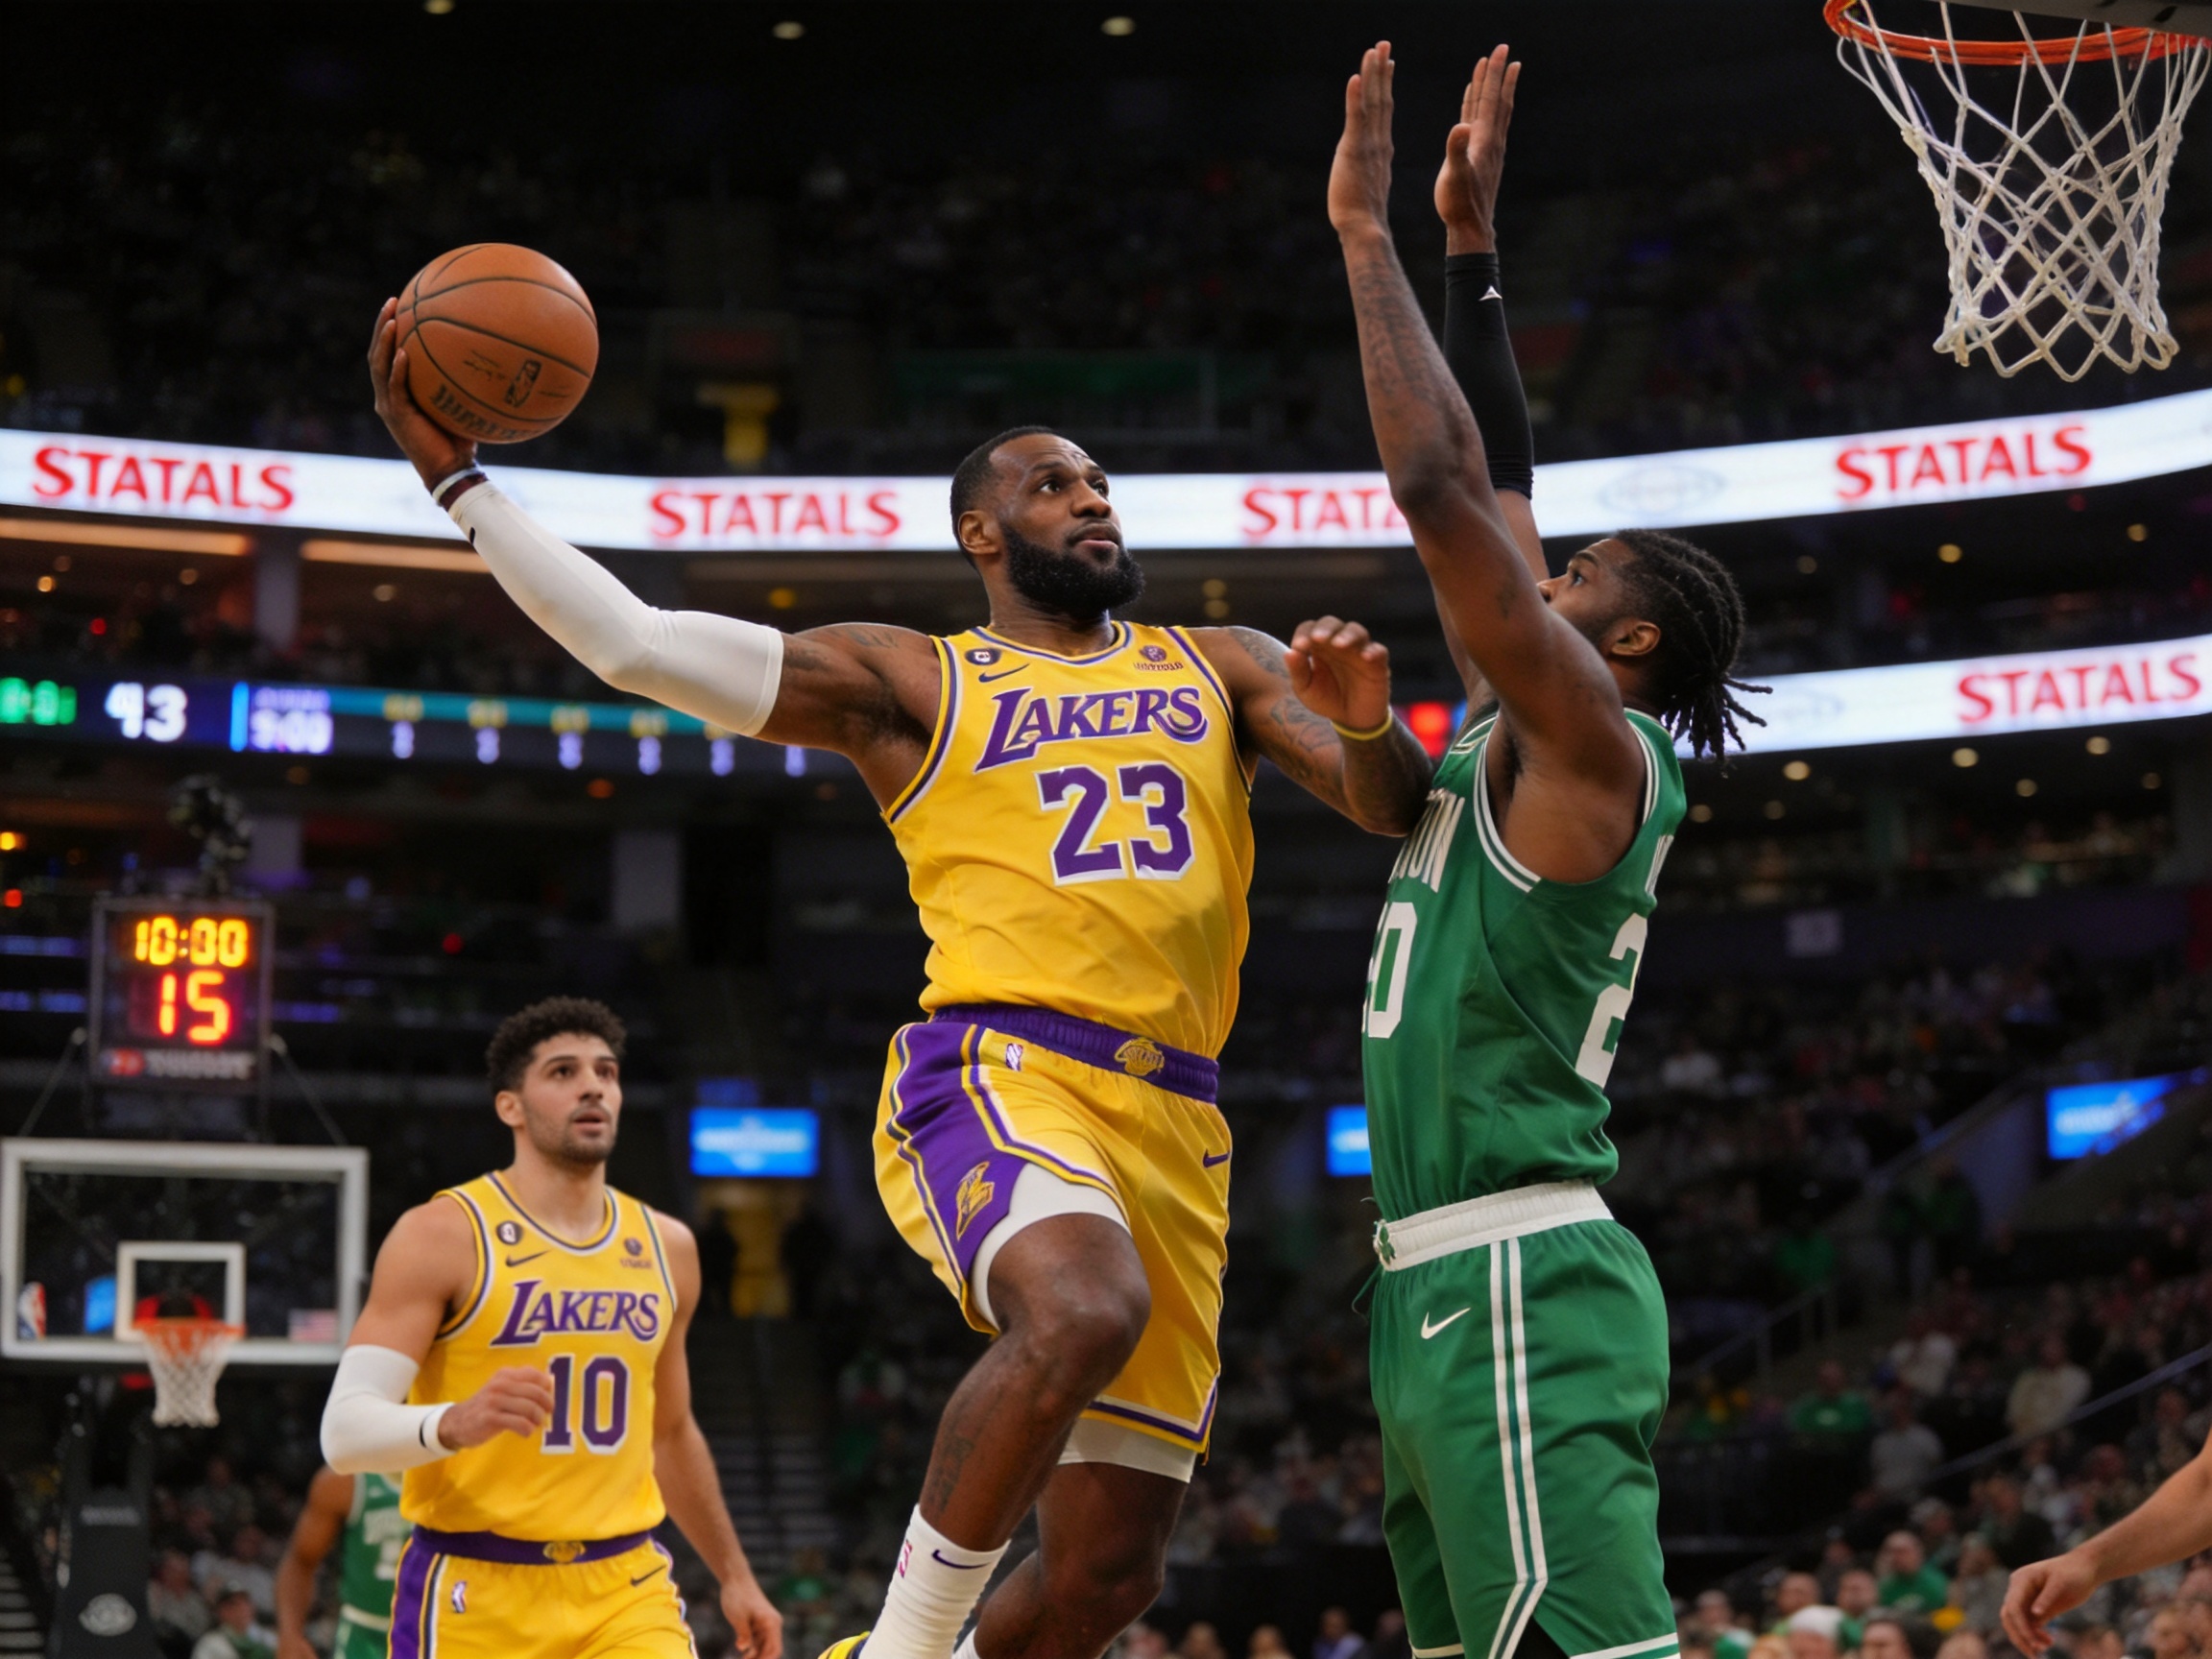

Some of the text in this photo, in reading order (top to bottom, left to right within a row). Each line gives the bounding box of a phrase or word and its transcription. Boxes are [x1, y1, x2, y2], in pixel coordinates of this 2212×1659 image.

[33, 445, 295, 513] STATALS
[1835, 424, 2093, 499] STATALS
[649, 490, 901, 538] STATALS
[104, 682, 188, 743] 43
[1957, 654, 2202, 724] STATALS
[974, 685, 1208, 774] LAKERS
[1034, 760, 1194, 885] 23
[134, 916, 250, 968] 10:00
[157, 970, 232, 1046] 15
[489, 1279, 660, 1348] LAKERS
[541, 1354, 630, 1455] 10
